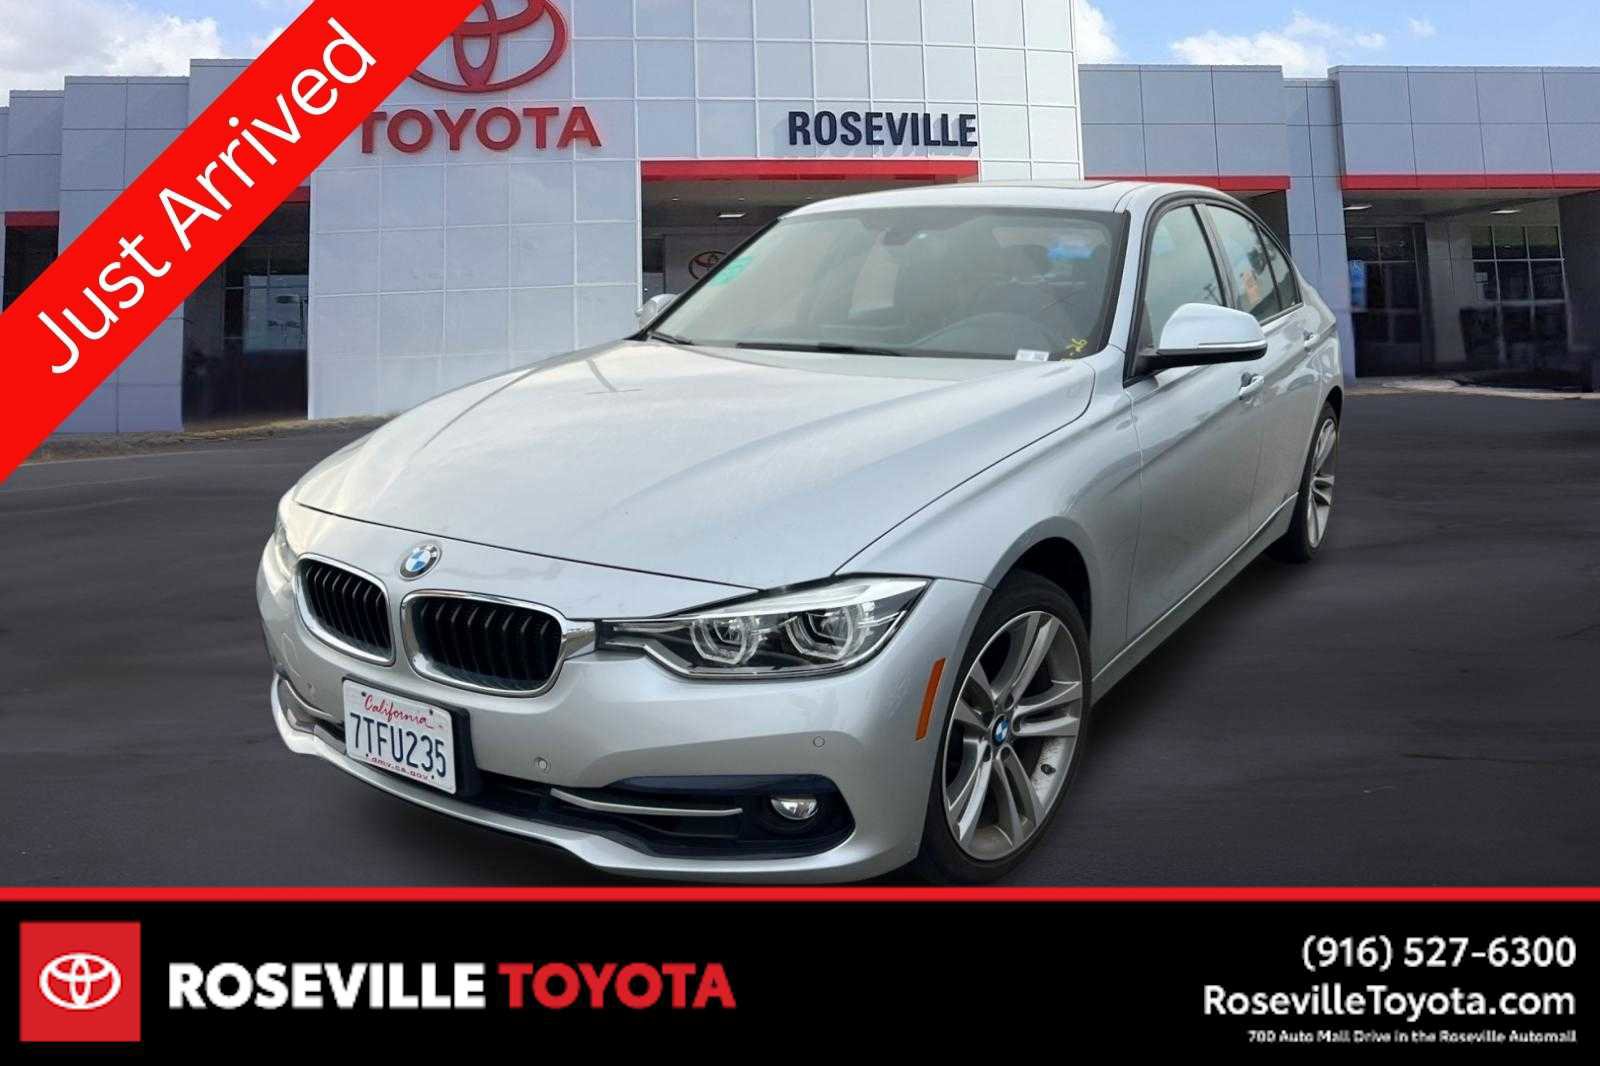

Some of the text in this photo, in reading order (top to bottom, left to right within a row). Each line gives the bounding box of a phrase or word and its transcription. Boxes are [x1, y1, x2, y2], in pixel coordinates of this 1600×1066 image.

[361, 106, 602, 154] TOYOTA
[788, 110, 979, 147] ROSEVILLE
[364, 694, 434, 729] California
[350, 712, 446, 778] 7TFU235
